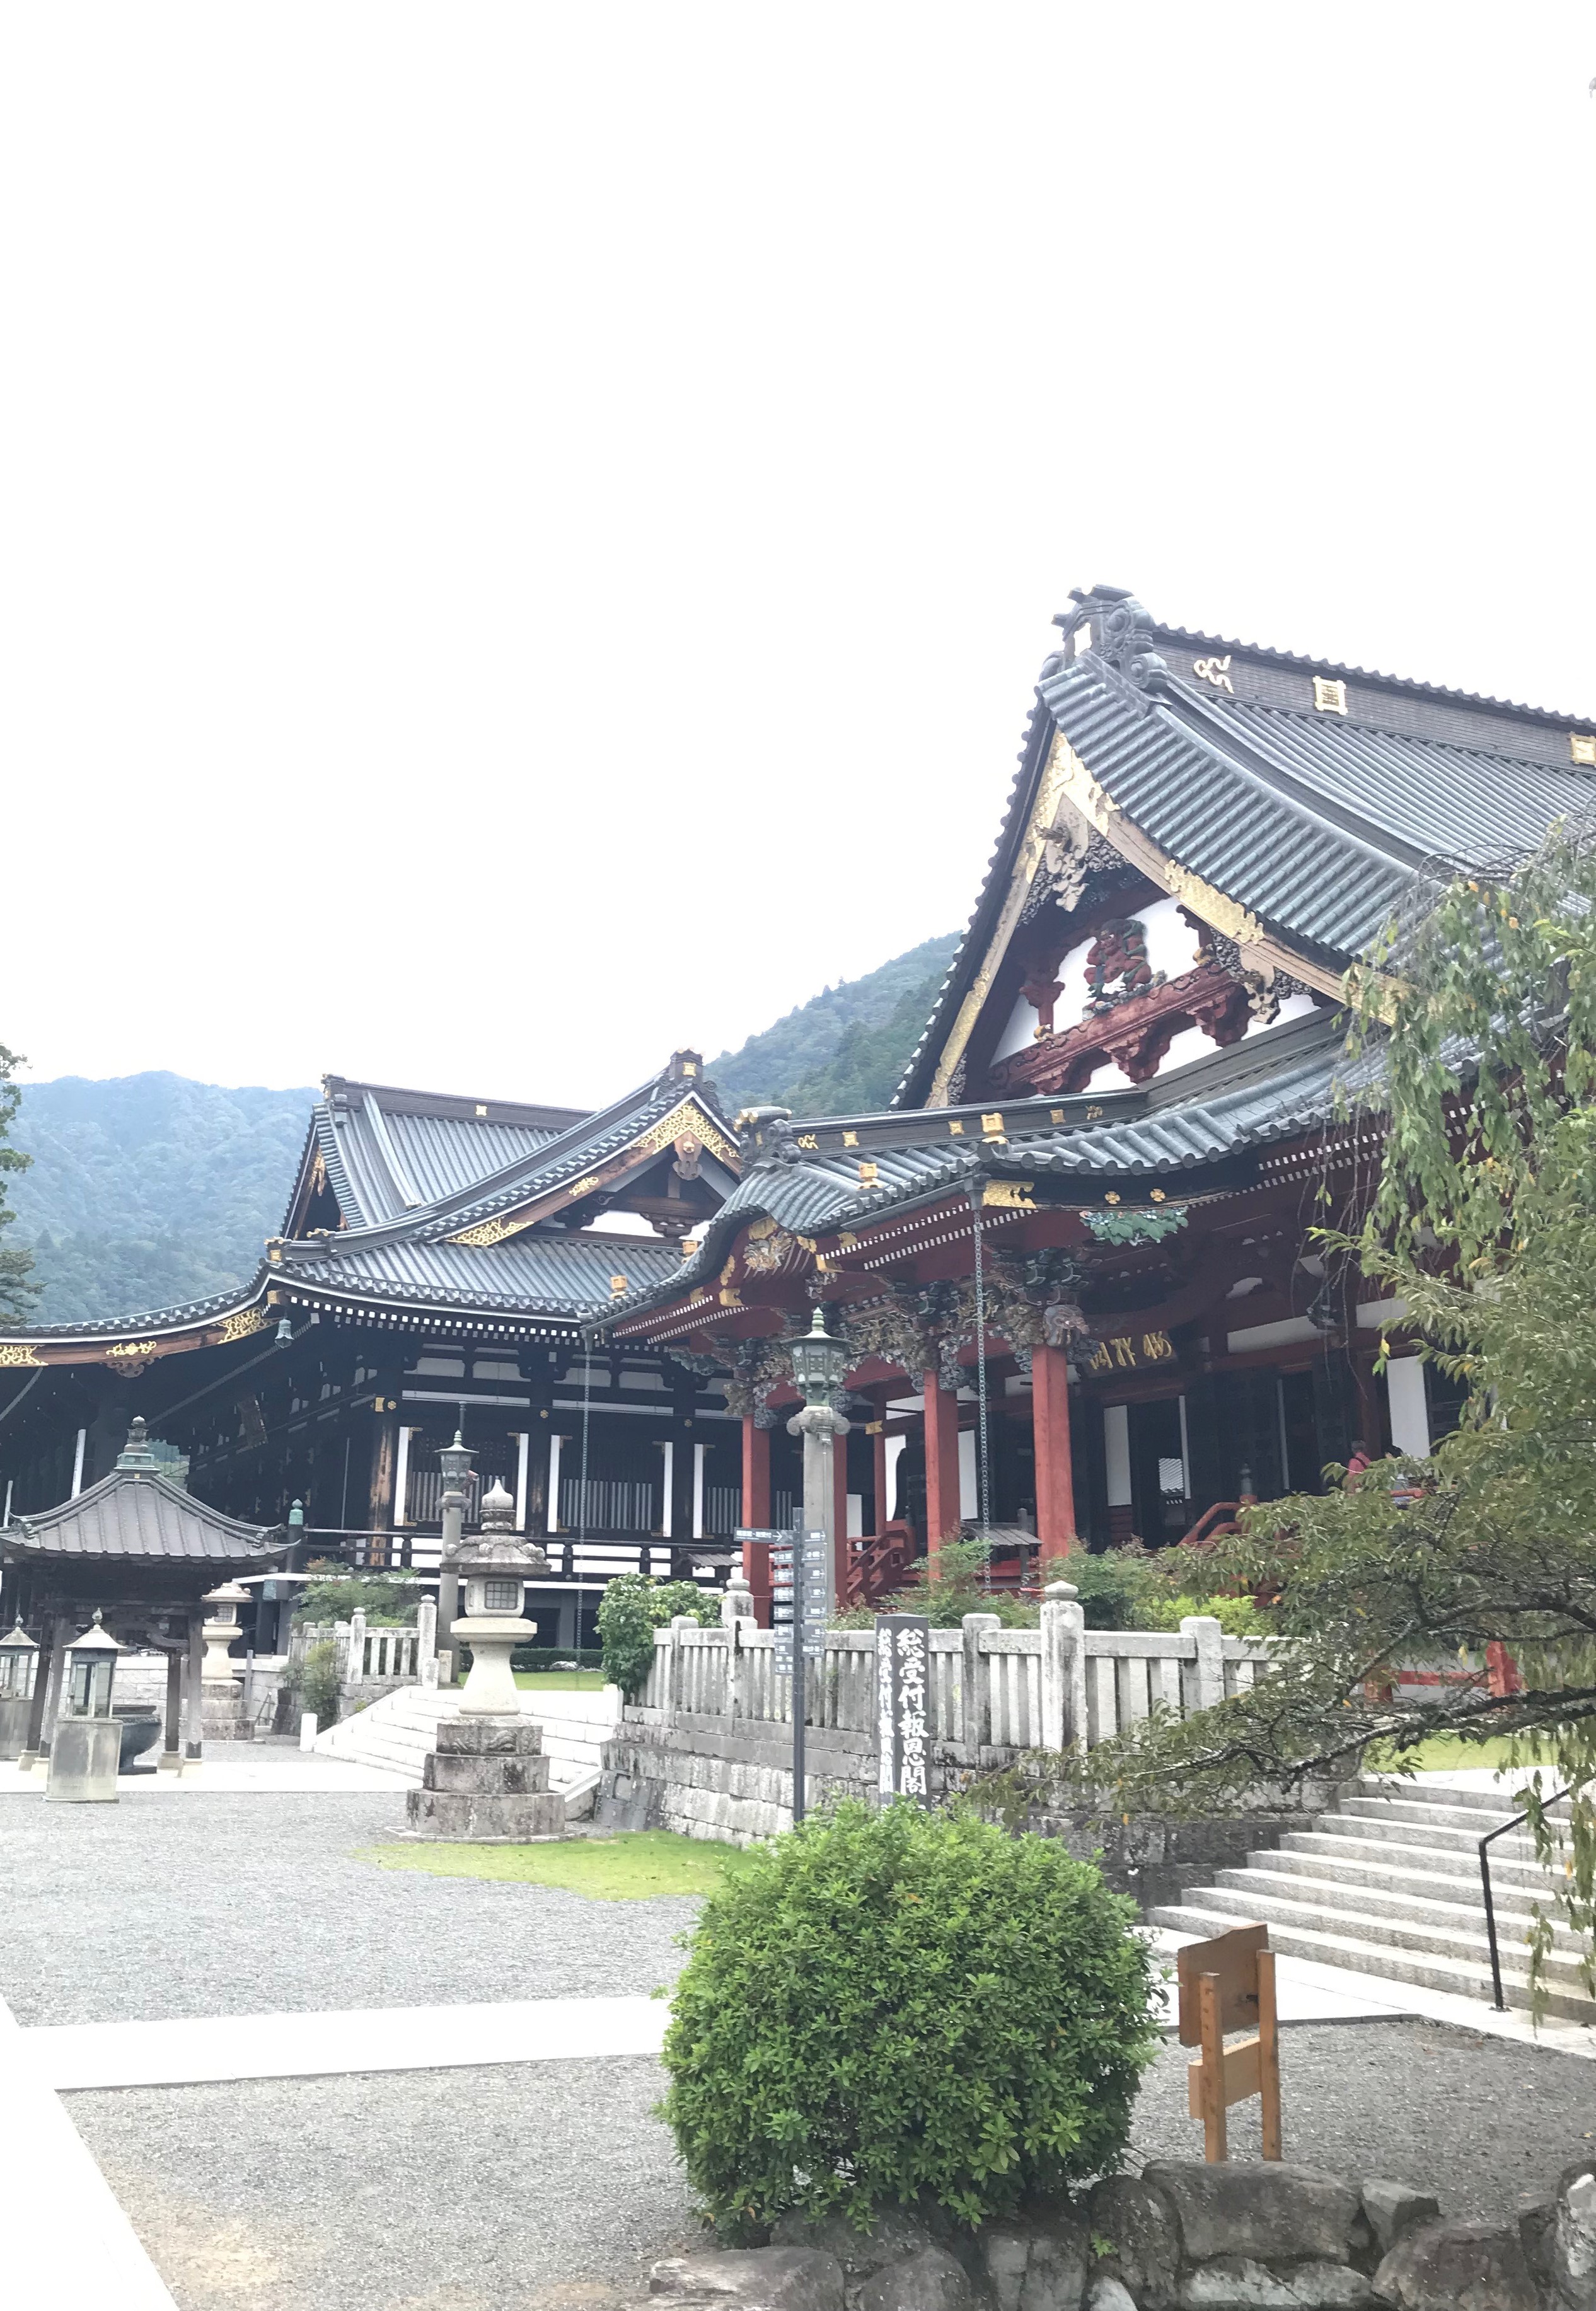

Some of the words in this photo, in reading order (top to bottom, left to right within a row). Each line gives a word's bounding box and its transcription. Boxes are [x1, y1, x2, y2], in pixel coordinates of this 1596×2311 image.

[896, 1628, 930, 1795] 総受付報恩閣
